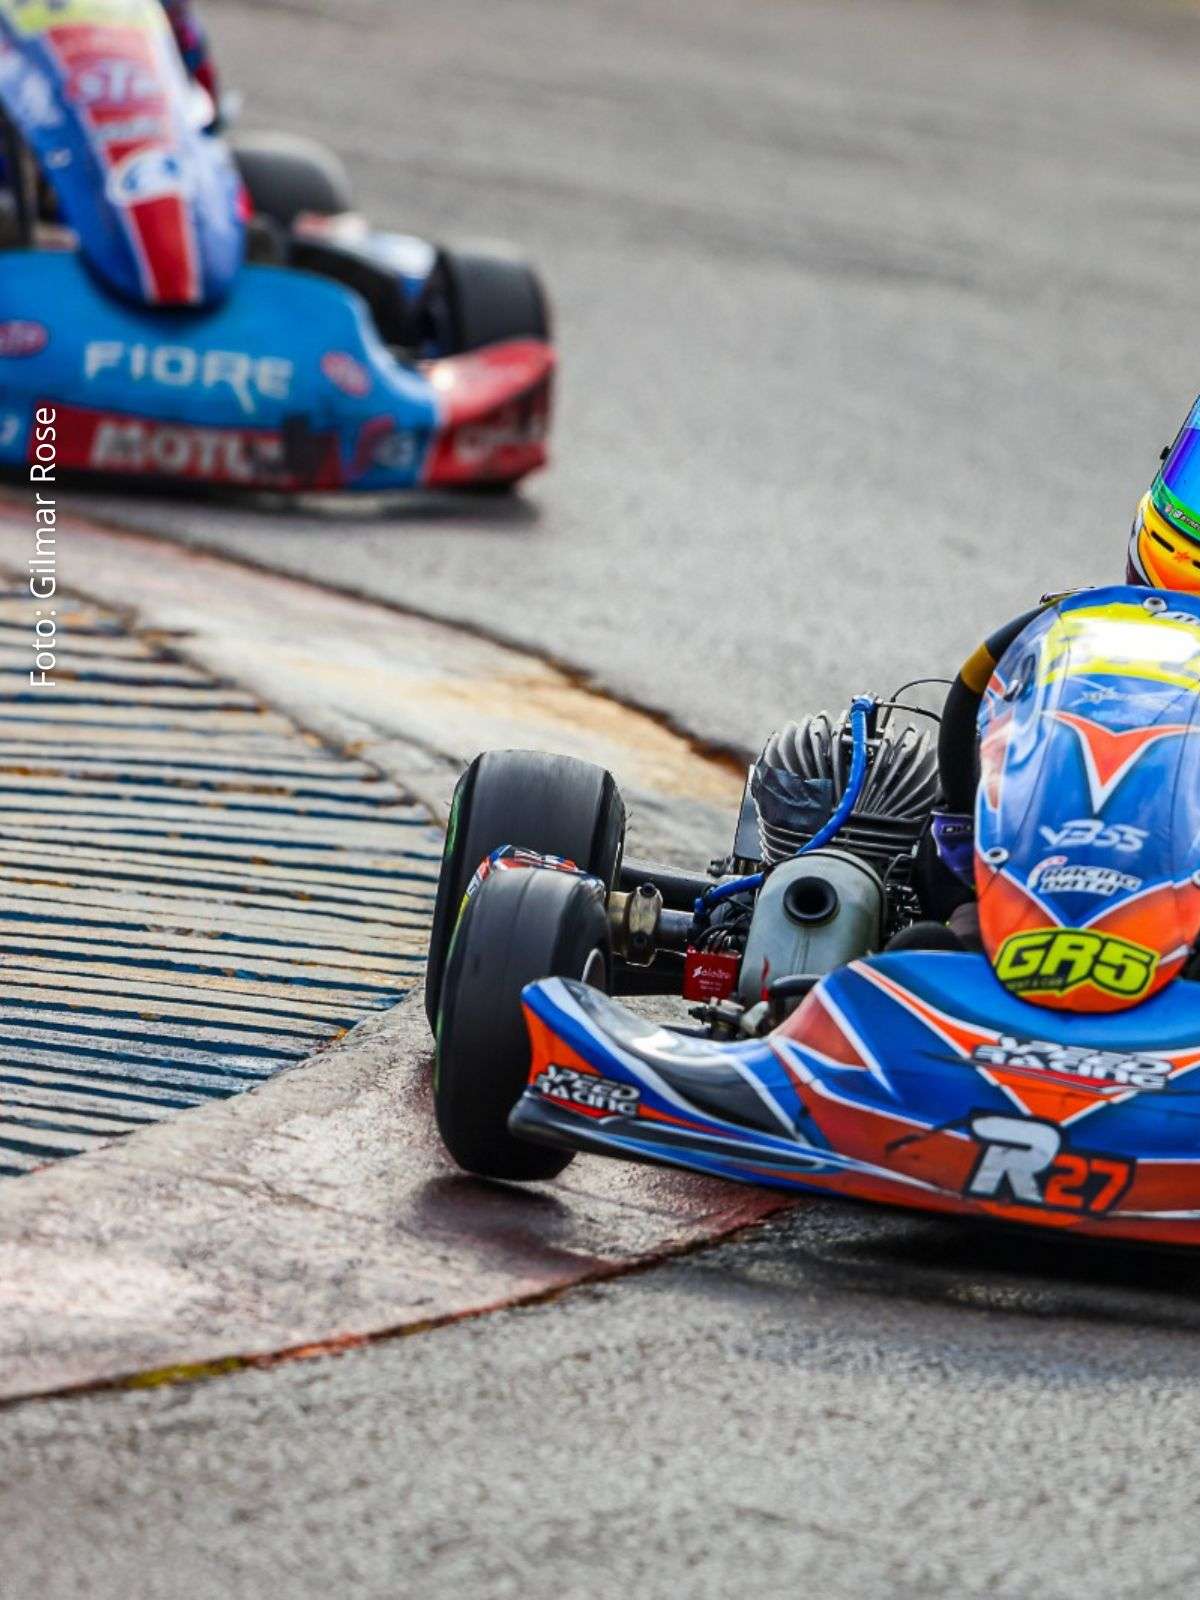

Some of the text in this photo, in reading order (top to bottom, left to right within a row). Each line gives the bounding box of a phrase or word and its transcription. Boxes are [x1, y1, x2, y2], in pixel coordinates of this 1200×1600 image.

[84, 340, 294, 414] FIORE
[1039, 879, 1118, 896] DATA
[996, 933, 1151, 993] GR5
